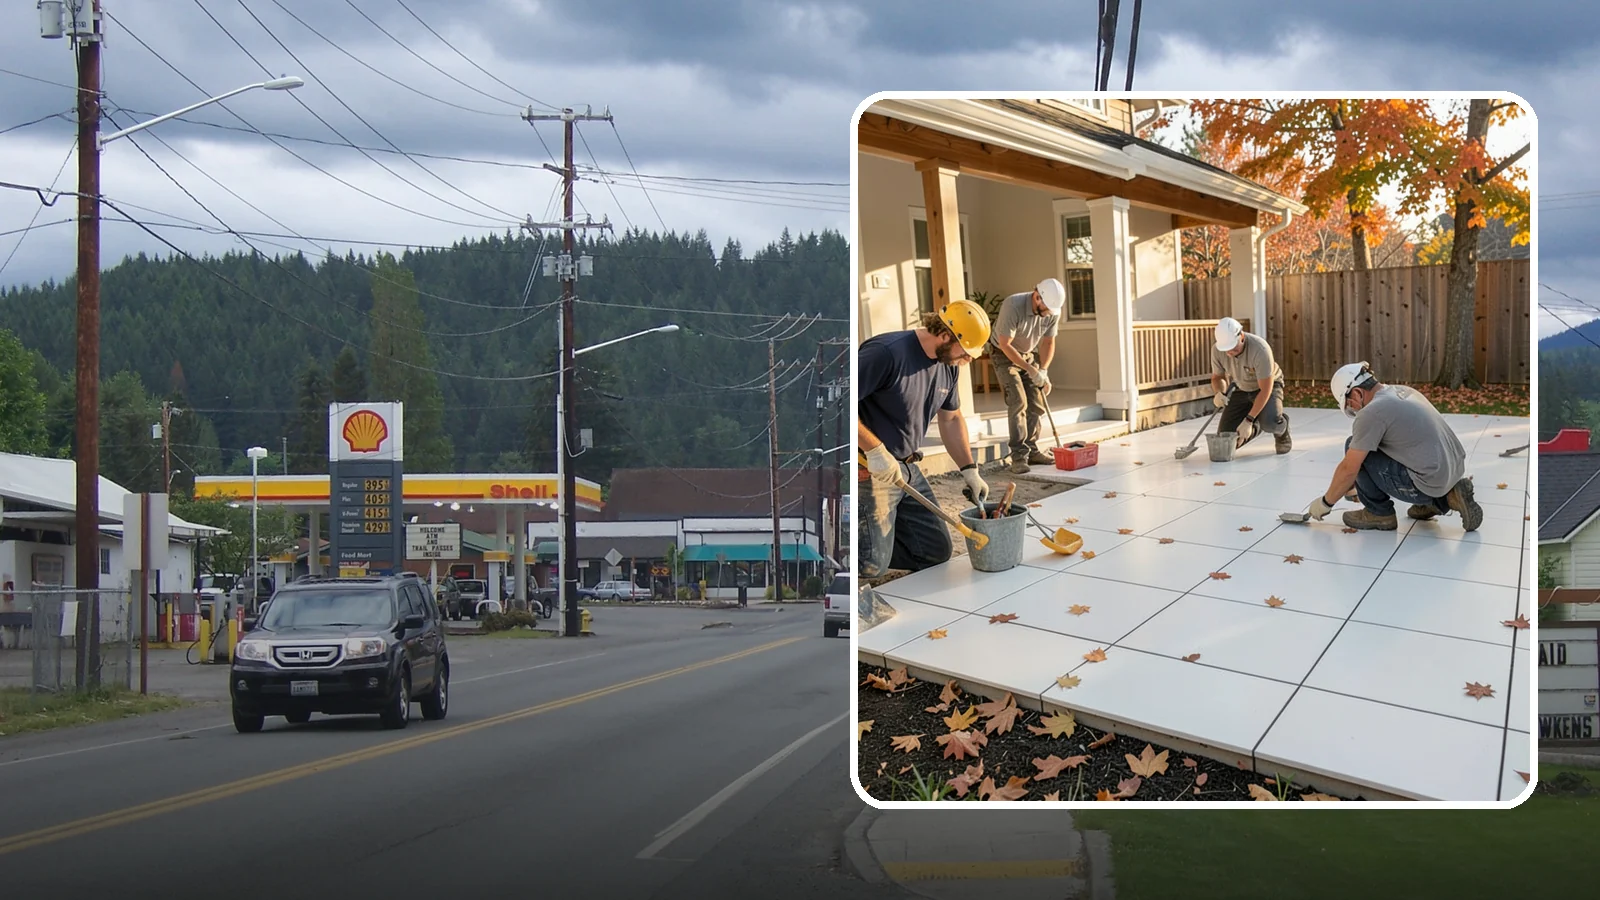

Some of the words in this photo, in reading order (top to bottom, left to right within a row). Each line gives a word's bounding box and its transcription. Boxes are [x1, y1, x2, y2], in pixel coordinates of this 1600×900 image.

[366, 480, 383, 490] 395
[490, 484, 547, 499] Shell
[366, 494, 383, 504] 405
[366, 508, 383, 518] 415
[366, 522, 383, 532] 429
